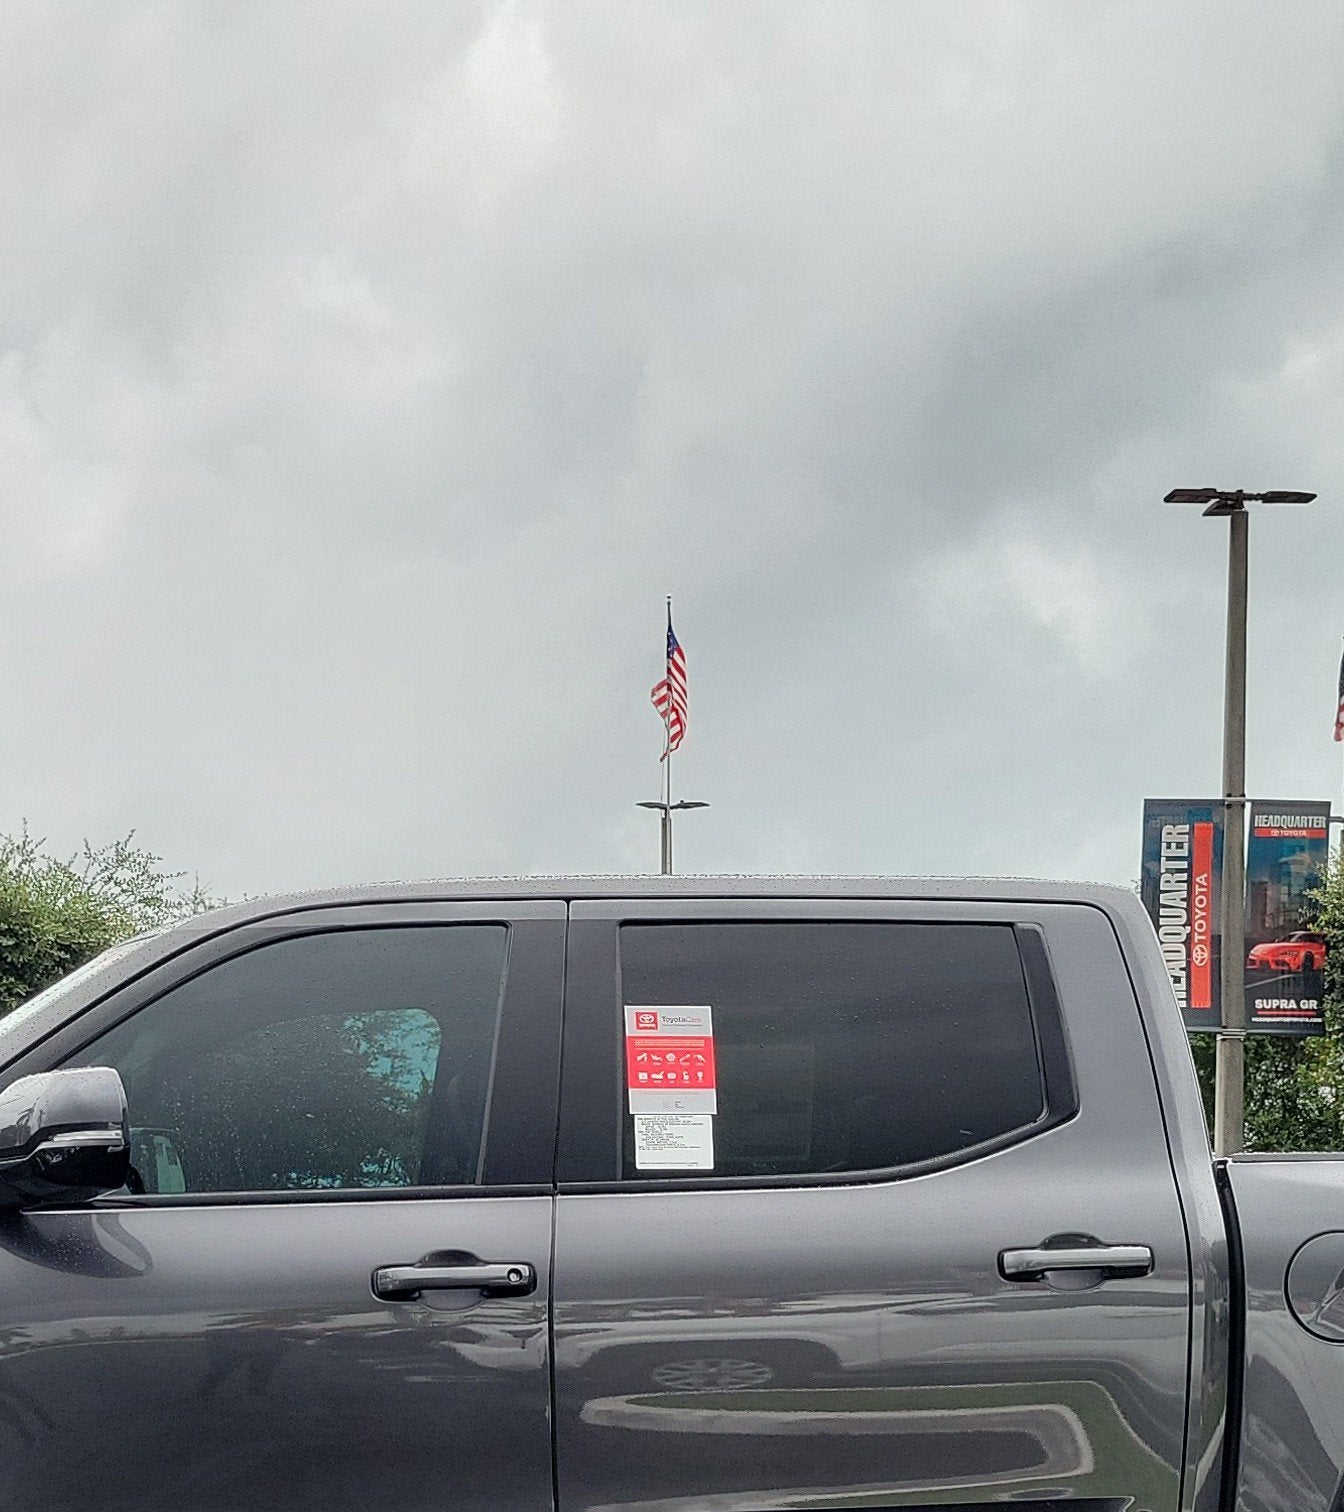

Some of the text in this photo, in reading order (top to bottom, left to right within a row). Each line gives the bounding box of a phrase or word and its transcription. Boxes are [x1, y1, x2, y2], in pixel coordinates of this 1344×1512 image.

[1254, 815, 1327, 828] HEADQUARTER
[1194, 873, 1208, 943] TOYOTA
[1254, 999, 1318, 1009] SUPRA GR
